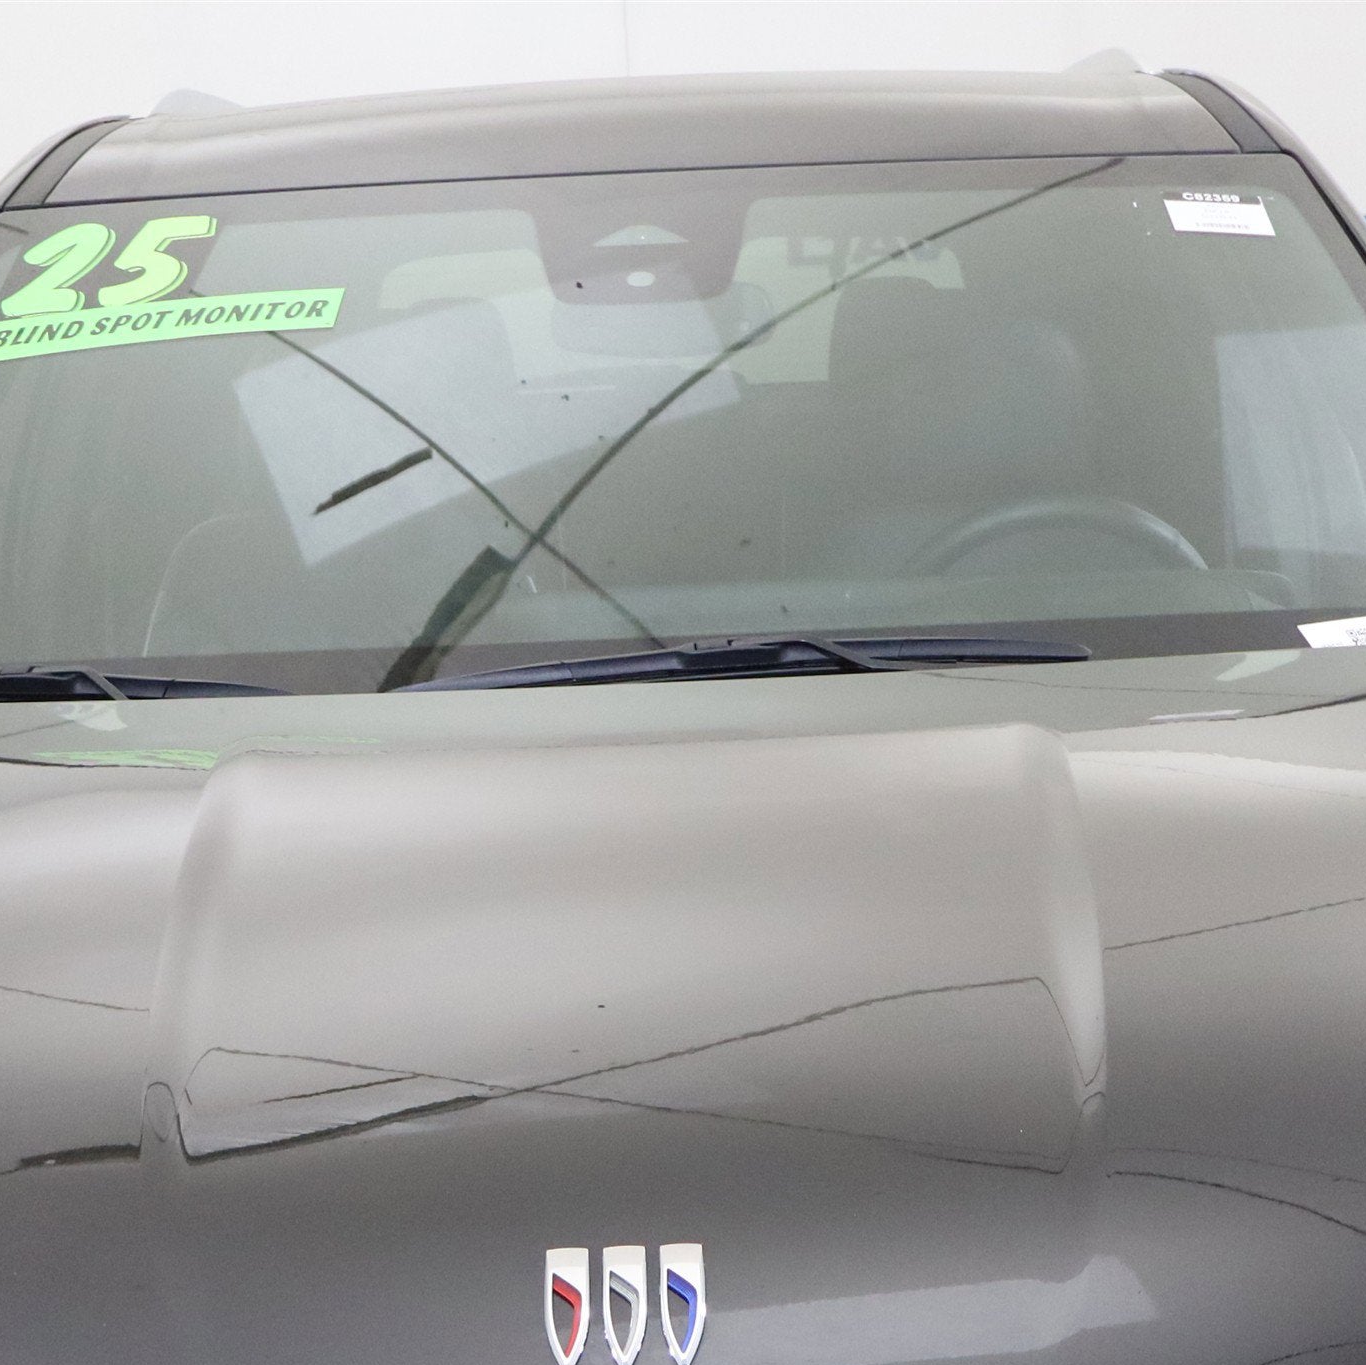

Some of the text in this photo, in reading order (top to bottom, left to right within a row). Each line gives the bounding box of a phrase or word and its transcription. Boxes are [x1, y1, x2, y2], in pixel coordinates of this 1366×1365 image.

[1, 215, 217, 319] 25
[90, 310, 175, 336] SPOT
[174, 300, 329, 328] MONITOR
